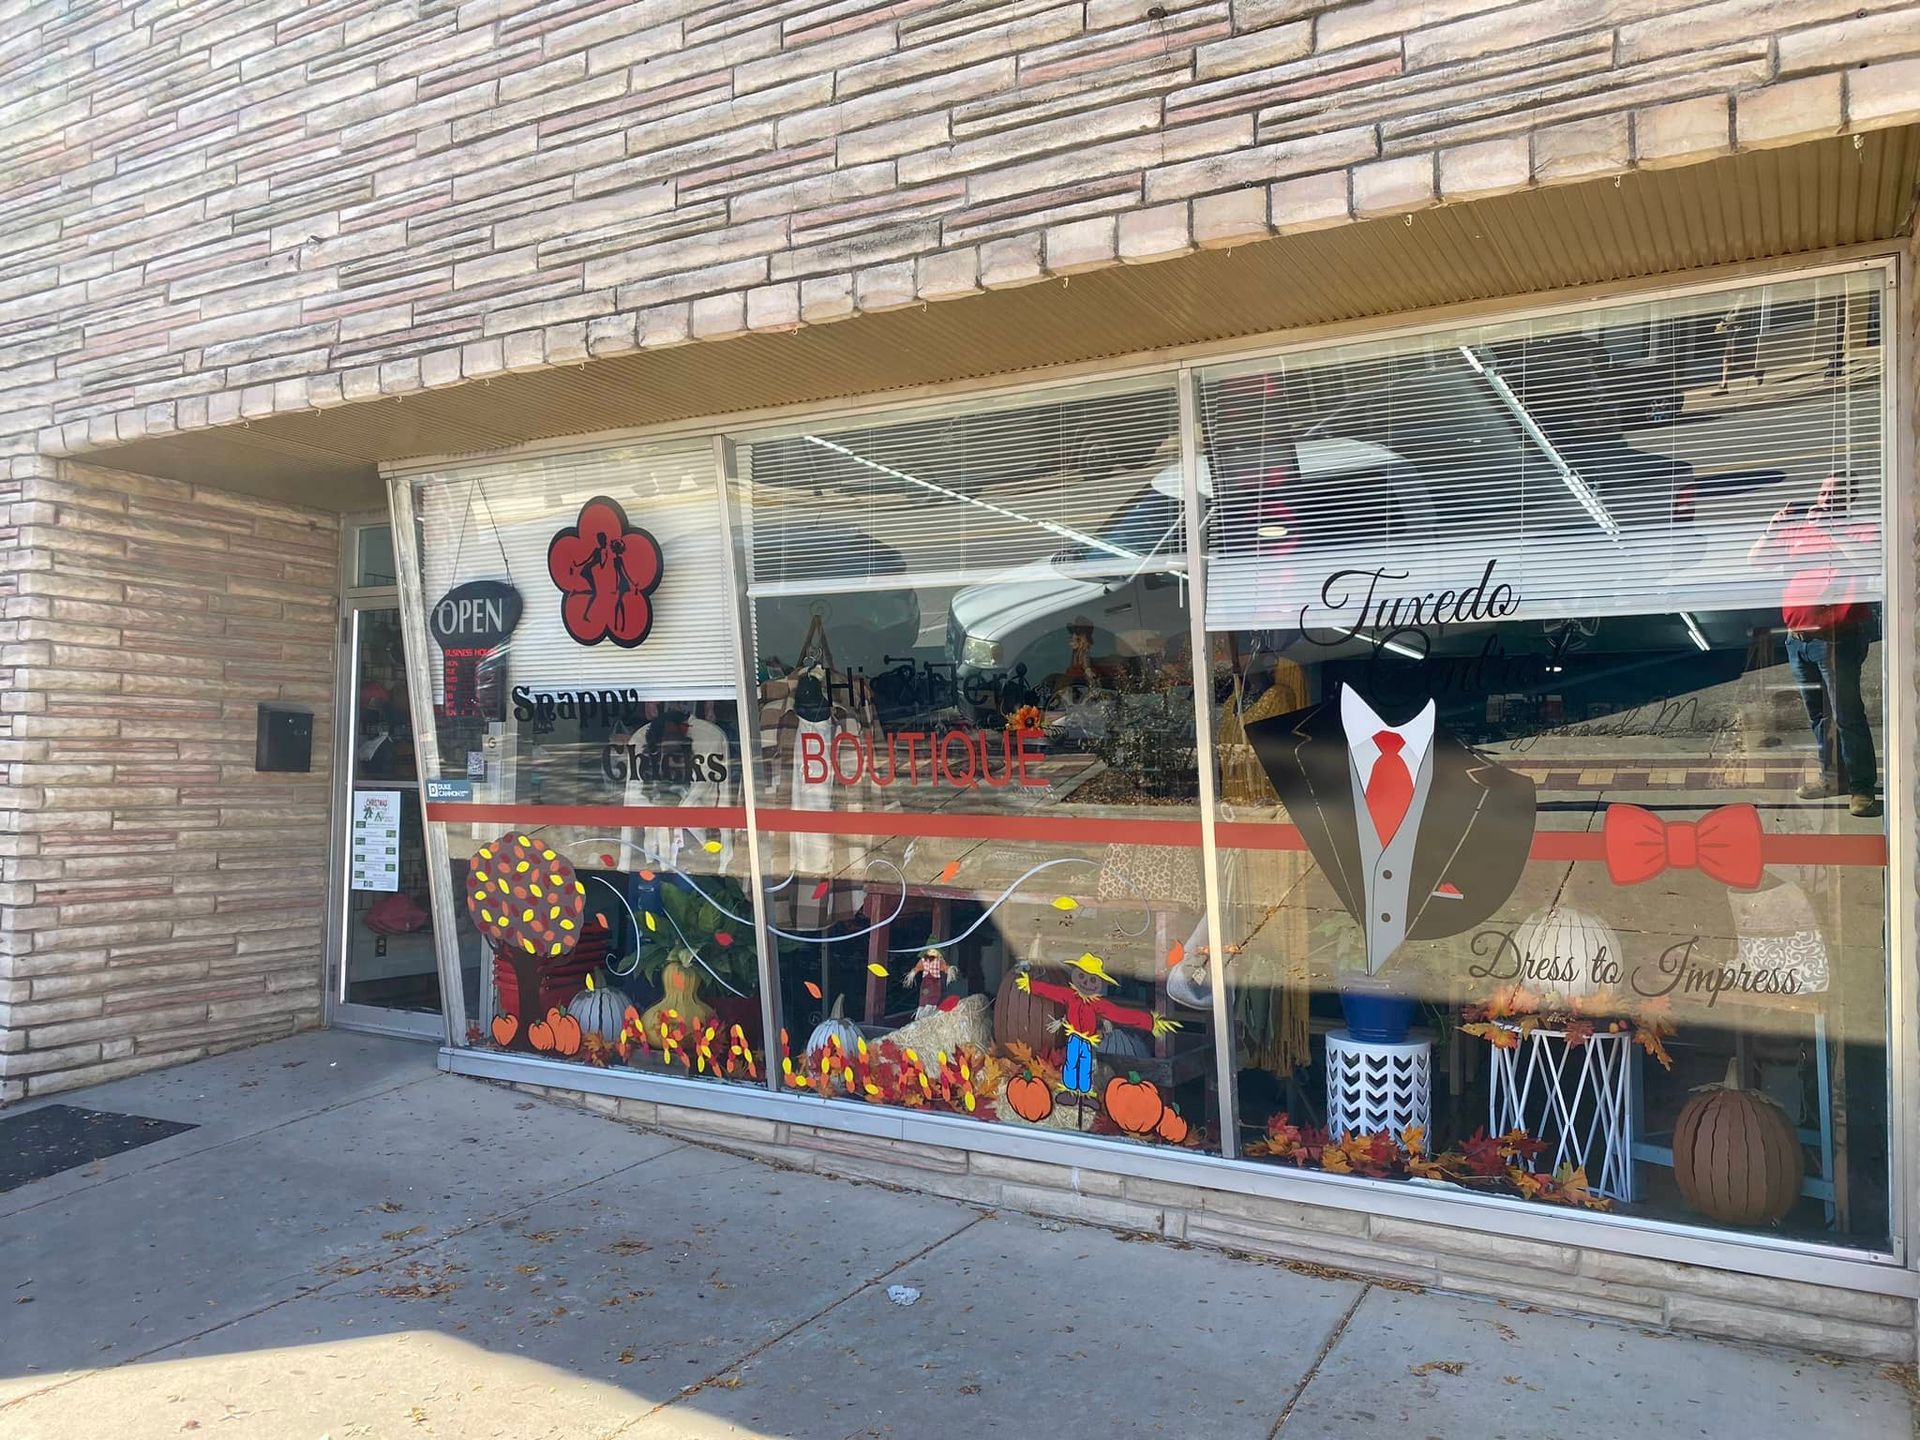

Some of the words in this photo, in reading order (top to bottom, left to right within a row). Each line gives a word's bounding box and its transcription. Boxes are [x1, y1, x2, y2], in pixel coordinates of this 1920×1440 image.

[437, 598, 503, 635] OPEN
[1300, 559, 1521, 645] Tuxedo
[512, 685, 641, 728] Snappy
[602, 743, 728, 784] Chicks
[801, 730, 1051, 790] BOUTIQUE
[1468, 930, 1579, 983] Dress
[1588, 946, 1623, 984] to
[1631, 936, 1803, 1008] Impress
